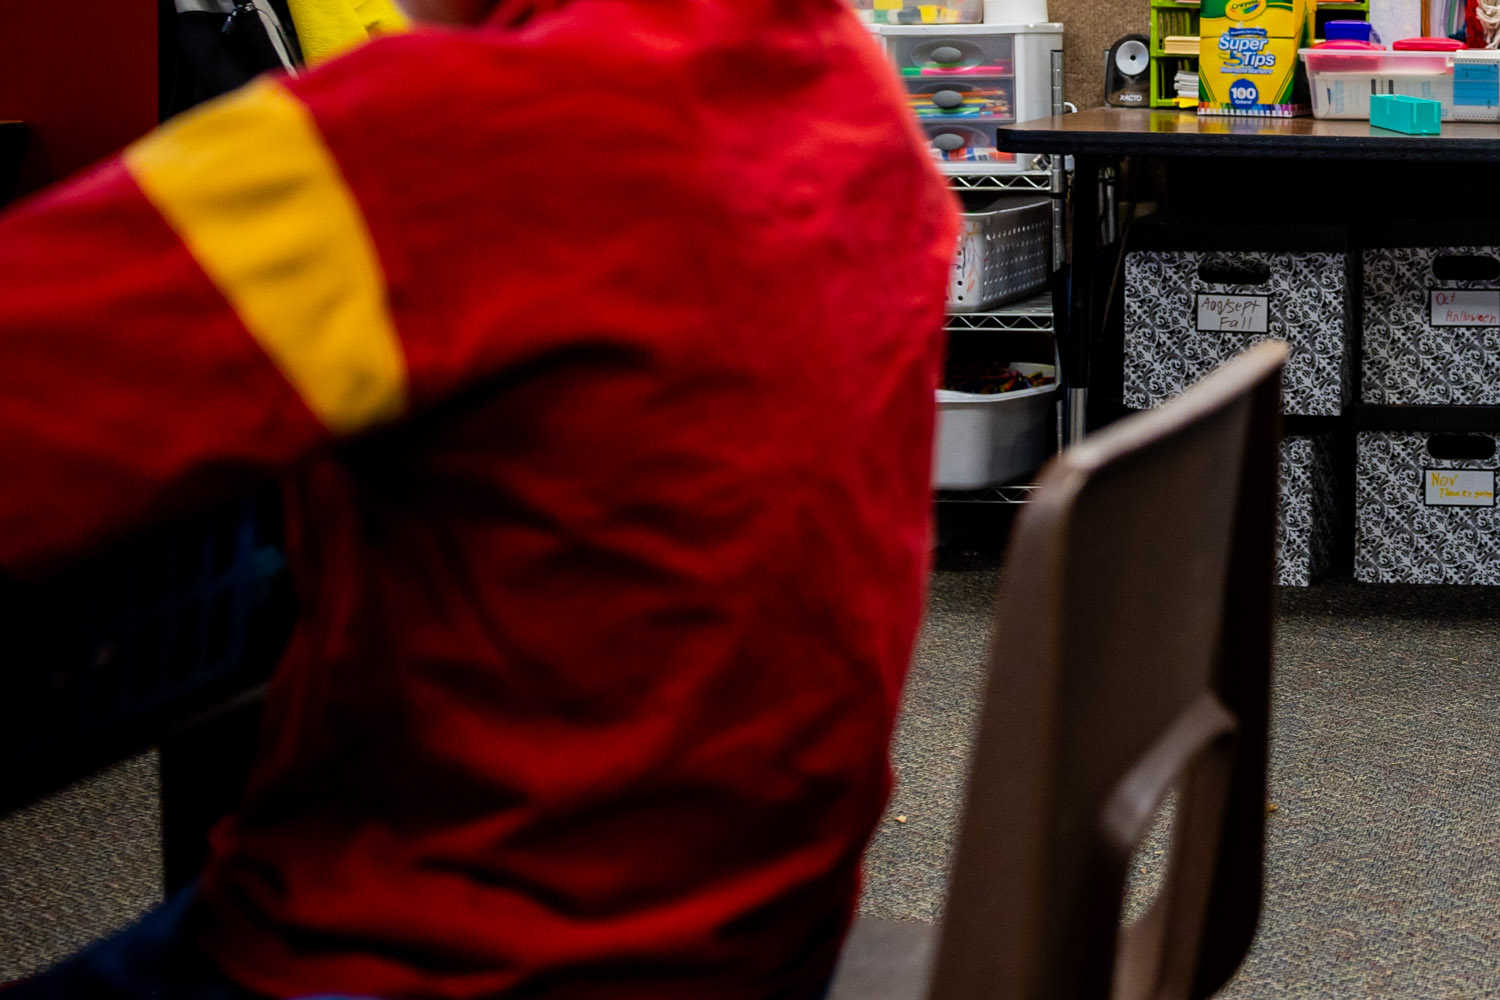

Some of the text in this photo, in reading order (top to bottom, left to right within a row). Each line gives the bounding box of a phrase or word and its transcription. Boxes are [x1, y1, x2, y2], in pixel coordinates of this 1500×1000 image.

[1218, 37, 1268, 51] Super
[1243, 52, 1276, 67] Tips
[1231, 87, 1256, 98] 100
[1219, 316, 1252, 331] Fall
[1431, 472, 1457, 487] Nov
